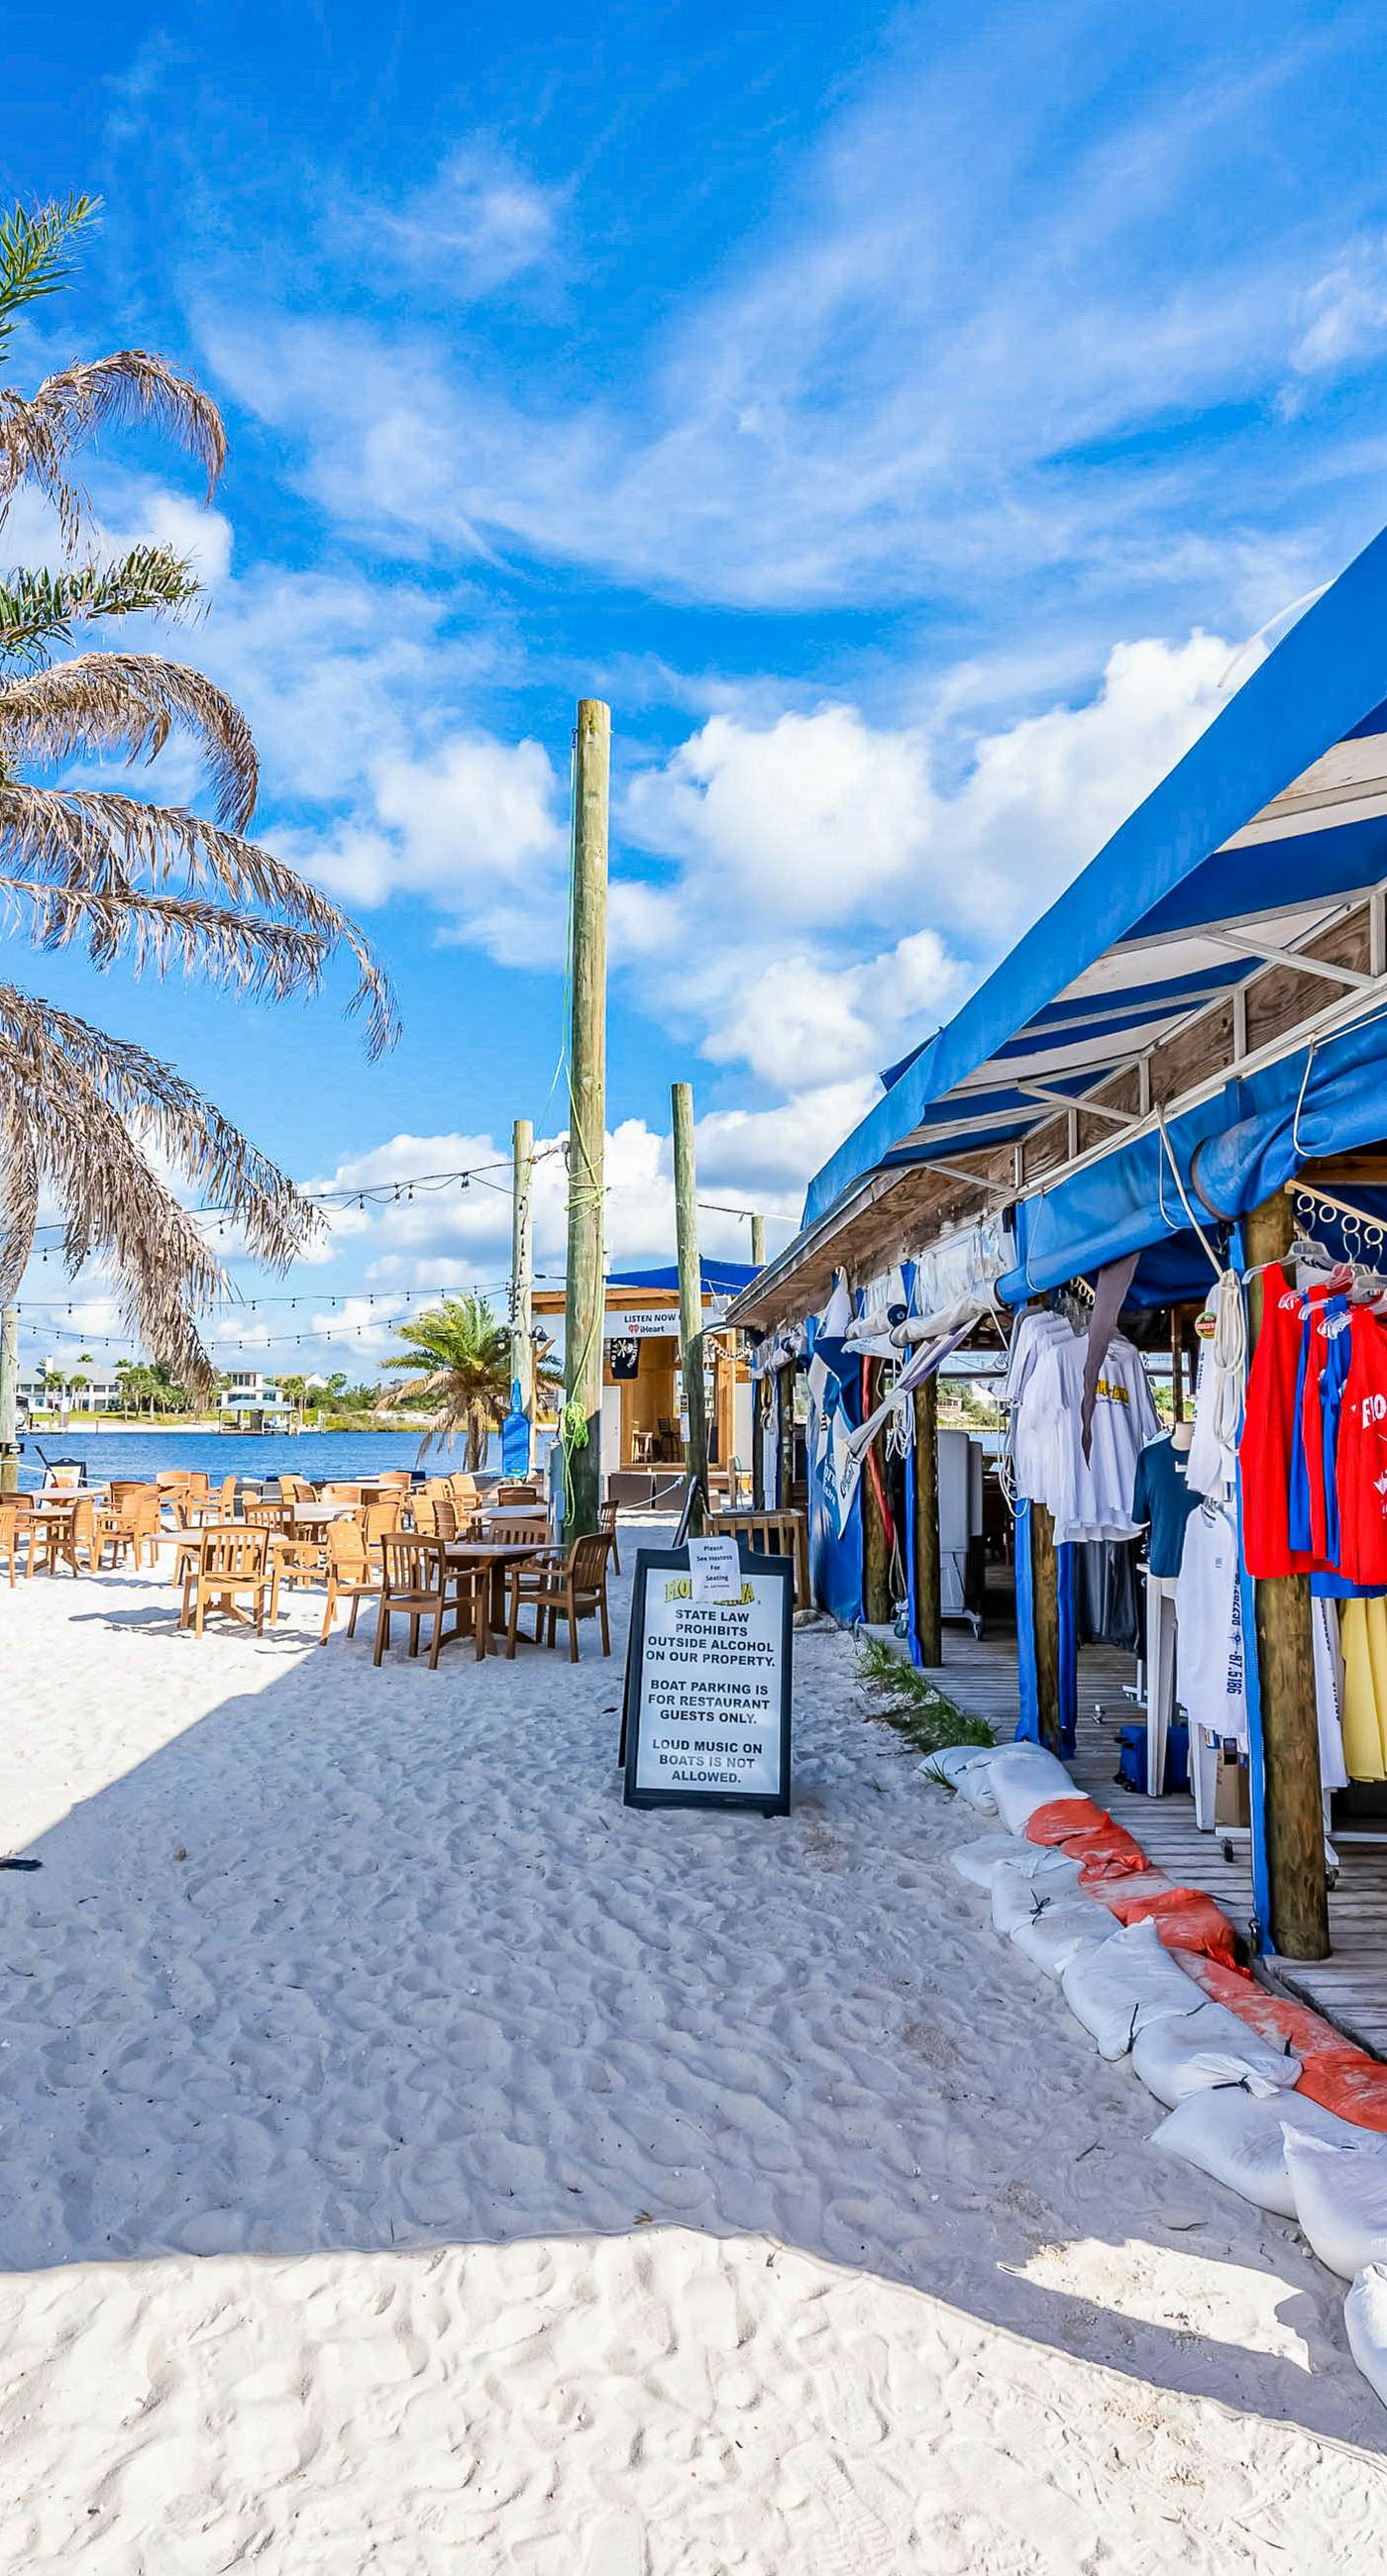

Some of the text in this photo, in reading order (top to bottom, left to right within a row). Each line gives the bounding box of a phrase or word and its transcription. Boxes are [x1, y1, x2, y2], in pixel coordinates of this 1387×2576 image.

[624, 1314, 652, 1323] LISTEN
[654, 1313, 677, 1322] NOW
[675, 1609, 750, 1623] STATE LAW
[676, 1623, 748, 1637] PROHIBITS
[648, 1636, 775, 1653] OUTSIDE ALCOHOL
[646, 1650, 776, 1667] ON OUR PROPERTY.
[650, 1680, 768, 1696] BOAT PARKING IS
[648, 1694, 771, 1709] FOR RESTAURANT
[660, 1709, 757, 1724] GUESTS ONLY.
[652, 1739, 763, 1754] LOUD MUSIC ON
[659, 1754, 755, 1769] BOATS IS NOT
[672, 1770, 741, 1784] ALLOWED.
